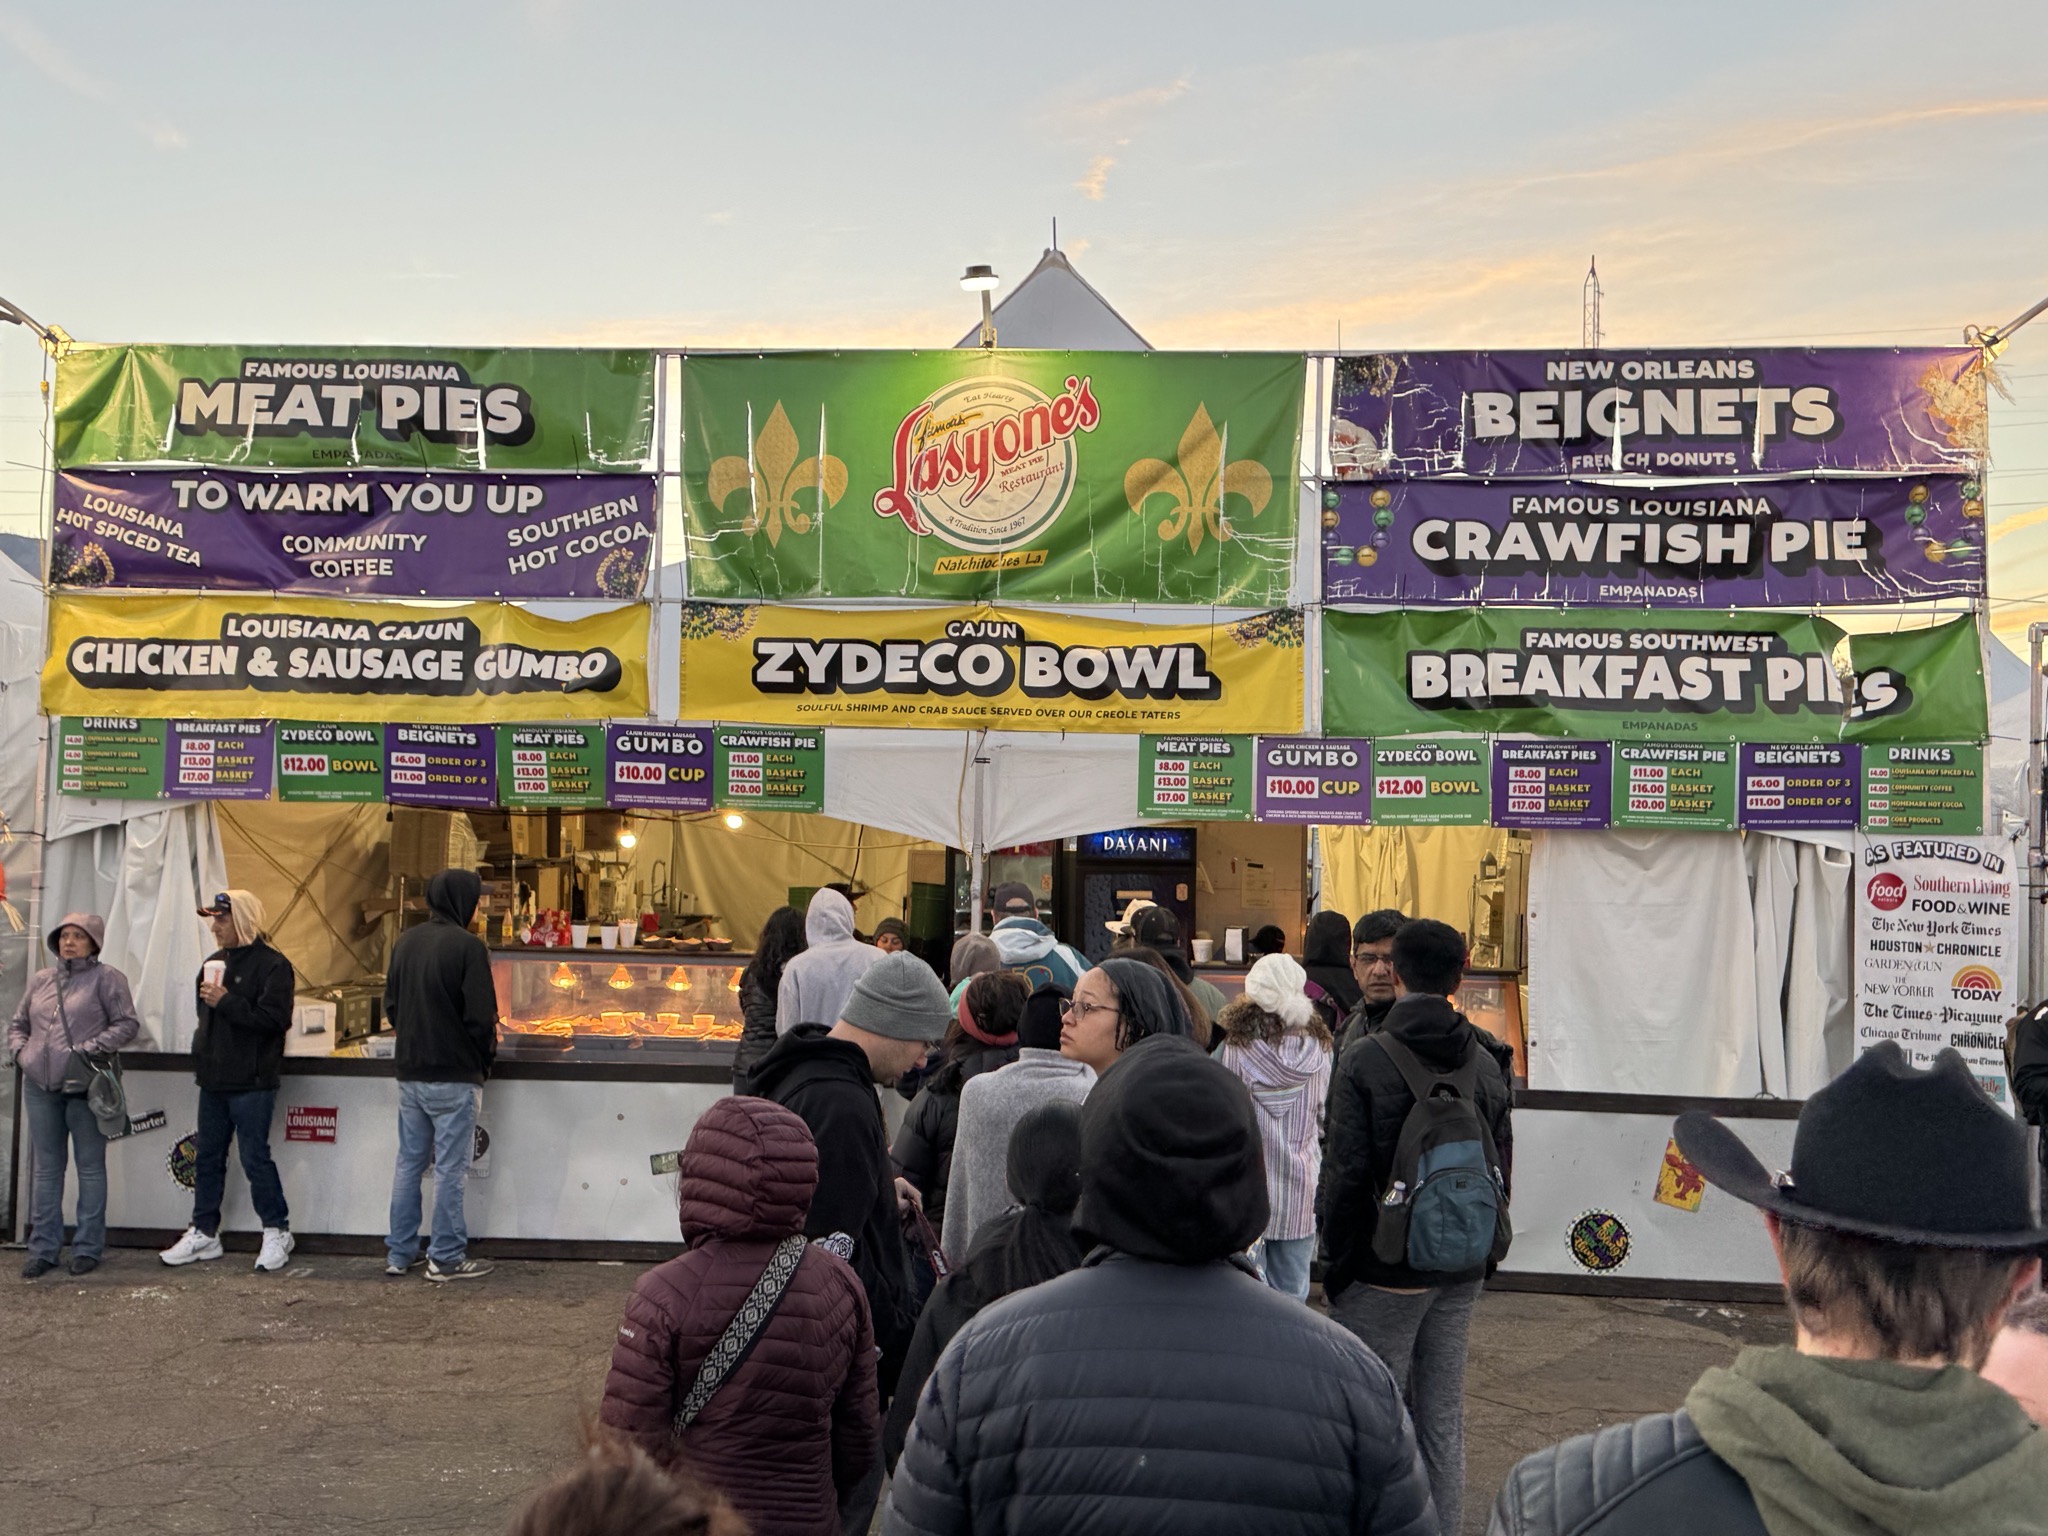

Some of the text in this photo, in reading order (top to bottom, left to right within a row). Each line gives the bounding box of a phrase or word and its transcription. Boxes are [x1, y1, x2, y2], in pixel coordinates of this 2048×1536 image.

[245, 362, 460, 381] FAMOUS LOUISIANA
[1547, 360, 1755, 381] NEW ORLEANS
[179, 382, 522, 434] MEAT PIES
[1472, 387, 1835, 439] BEIGNETS
[312, 449, 402, 460] EMPAADAS
[876, 376, 1099, 534] Lasyone's
[1572, 452, 1736, 470] FRENCH DONUTS
[1000, 455, 1044, 477] MEAT PIE
[999, 460, 1065, 493] Restaurant
[172, 480, 543, 513] TO WARM YOU UP
[1512, 497, 1771, 517] FAMOUS LOUISIANA
[83, 494, 184, 539] LOUISIANA
[507, 495, 639, 547] SOUTHERN
[946, 515, 1026, 535] A Tradition Since 1967
[56, 508, 201, 568] HOT SPICED TEA
[282, 534, 427, 553] COMMUNITY
[1412, 519, 1867, 564] CRAWFISH PIE
[508, 521, 650, 575] HOT COCOA
[310, 559, 393, 578] COFFEE
[937, 552, 1043, 572] Natchitoches La.
[1600, 585, 1698, 598] EMPANADAS
[227, 618, 464, 641] LOUISIANA CAJUN
[948, 622, 1017, 639] CAJUN
[1526, 632, 1773, 652] FAMOUS SOUTHWEST
[72, 643, 607, 682] CHICKEN & SAUSAGE GUMBO
[756, 642, 1210, 690] ZYDECO BOWL
[1411, 652, 1751, 700] BREAKFAST
[796, 703, 1181, 720] SOULFUL SHRIMP AND CRAB SAUCE SERVED OVER OUR CREOLE TATERS
[83, 718, 138, 729] DRINKS
[175, 723, 261, 734] BREAKFAST PIES
[1622, 720, 1698, 732] EMPANADAS
[281, 729, 374, 741] ZYDECO BOWL
[398, 729, 477, 745] BEIGNETS
[512, 733, 585, 744] MEAT PIES
[720, 736, 816, 748] CRAWFISH PIE
[616, 736, 703, 754] GUMBO
[1156, 742, 1231, 753] MEAT PIES
[1267, 750, 1358, 767] GUMBO
[1377, 750, 1477, 762] ZYDECO BOWL
[1502, 750, 1597, 760] BREAKFAST PIES
[1620, 748, 1726, 761] CRAWFISH PIE
[1754, 751, 1841, 763] BEIGNETS
[1888, 748, 1951, 761] DRINKS
[284, 757, 378, 772] $12.00 BOWL
[1159, 761, 1220, 771] $8.00 EACH
[1633, 768, 1700, 777] $11.00 EACH
[619, 765, 705, 781] $10.00 CUP
[1514, 768, 1578, 778] $8.00 EACH
[1157, 777, 1186, 786] $13.00
[1192, 777, 1232, 785] BASKET
[1270, 779, 1360, 795] $10.00 CUP
[1378, 779, 1480, 795] $12.00 BOWL
[1512, 785, 1542, 794] $13.00
[1632, 784, 1713, 793] $16.00 BASKET
[1751, 779, 1851, 788] $6.00 ORDER OF 3
[1157, 793, 1185, 802] $17.00
[1192, 792, 1232, 800] BASKET
[1631, 800, 1665, 810] $20.00
[1670, 799, 1713, 808] BASKET
[1749, 798, 1852, 806] $11.00 ORDER OF 6
[1512, 801, 1541, 810] $17.00
[1104, 833, 1167, 854] DASANI
[1865, 841, 2003, 873] AS FEATURED IN
[1869, 880, 1905, 900] food
[1914, 874, 2010, 898] Southern Living
[1872, 917, 2002, 937] The New York Times
[1870, 939, 2002, 957] HOUSTON CHRONICLE
[1894, 976, 1907, 984] THE
[1864, 983, 1934, 998] NEW YORKER
[1951, 988, 2002, 1002] TODAY
[1863, 1002, 1889, 1018] The
[1860, 1026, 1942, 1041] Chicago Tribune
[1950, 1033, 2004, 1050] CHRONICLE
[288, 1115, 335, 1127] LOUISIANA
